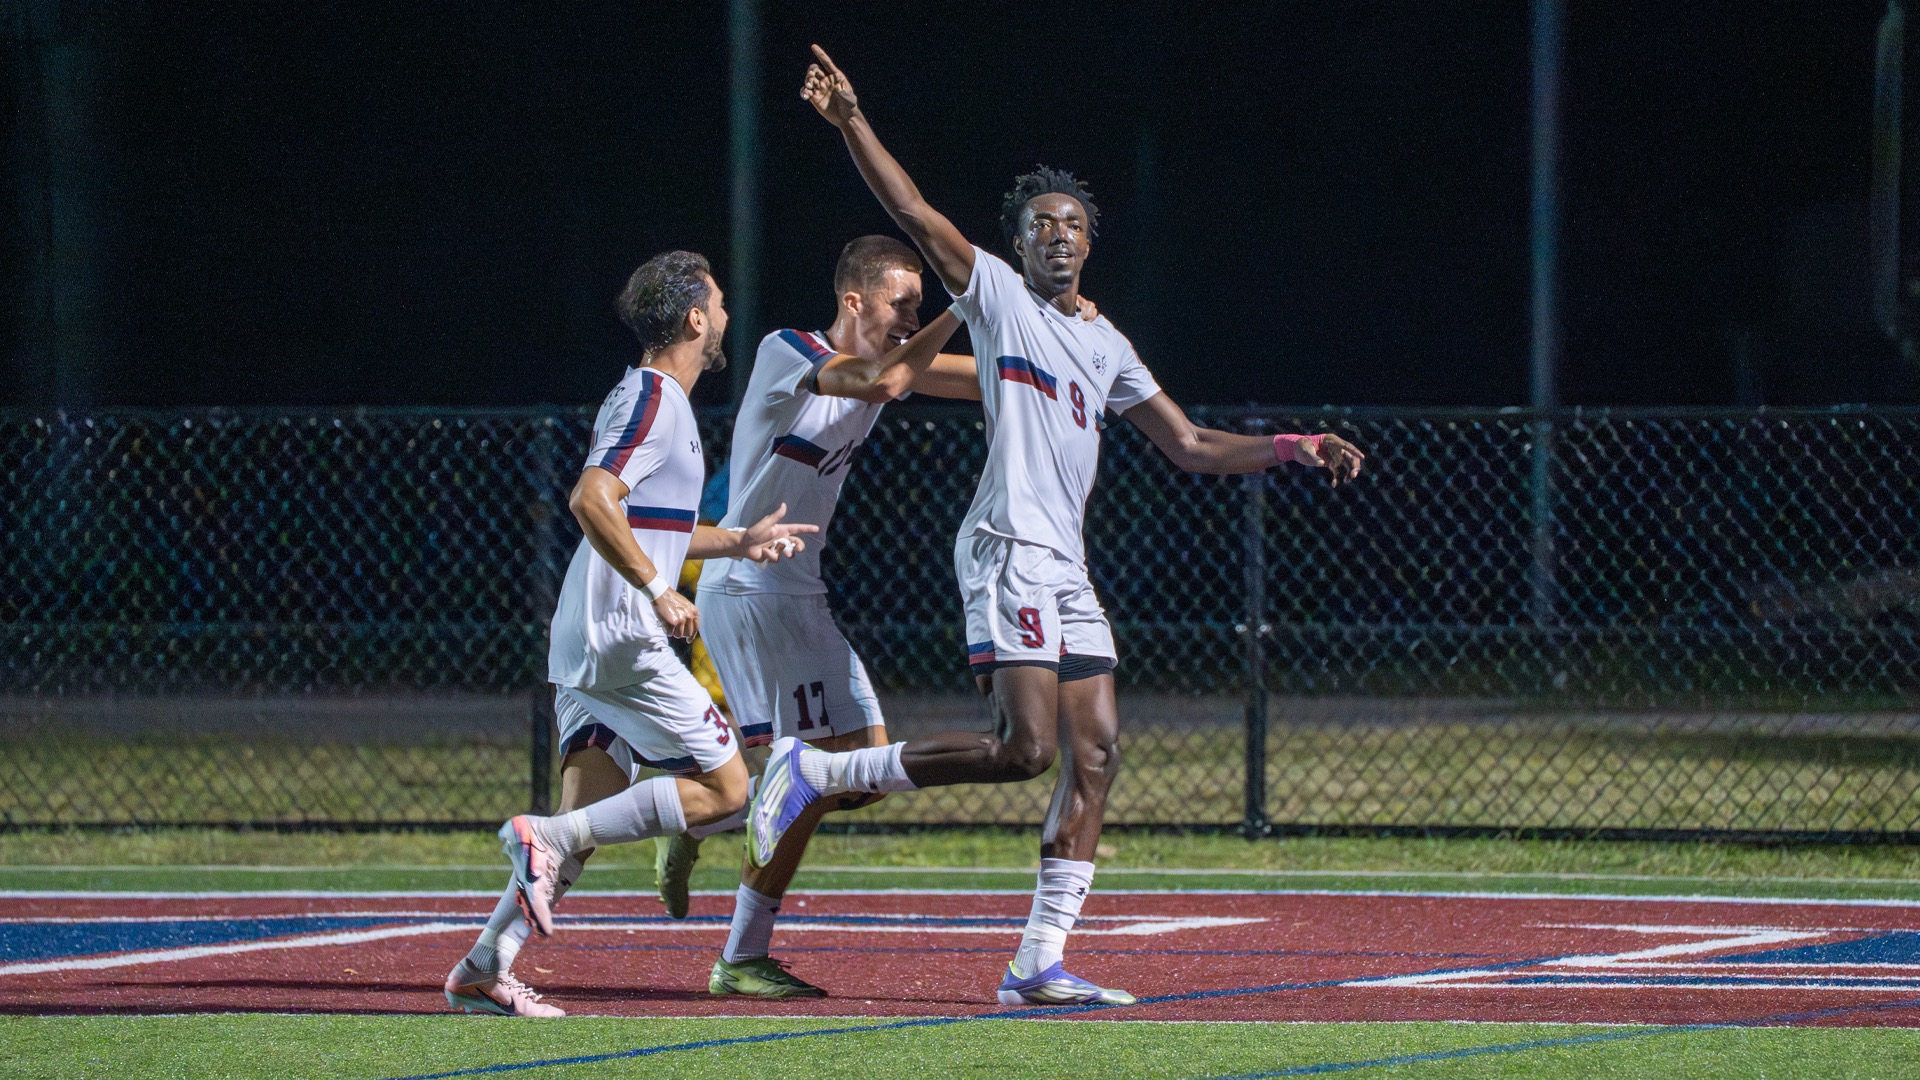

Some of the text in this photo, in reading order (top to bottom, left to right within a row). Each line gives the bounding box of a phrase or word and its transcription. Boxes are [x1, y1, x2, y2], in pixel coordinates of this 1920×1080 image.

[1069, 379, 1087, 431] 9
[1018, 607, 1045, 648] 9
[703, 704, 732, 745] 3
[793, 681, 830, 730] 17
